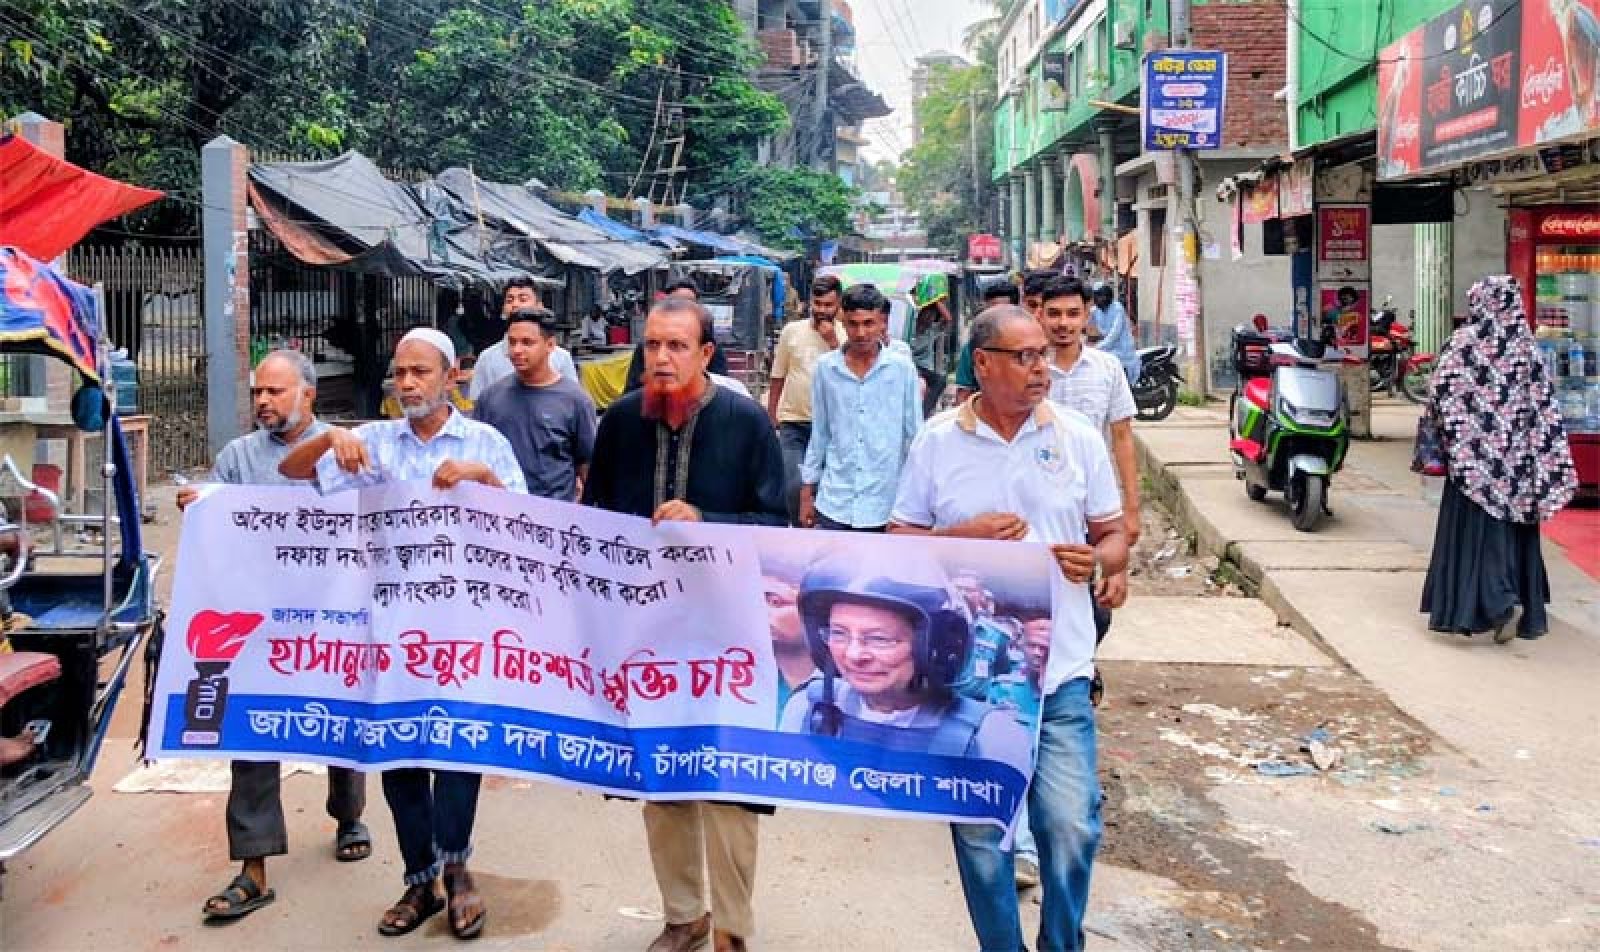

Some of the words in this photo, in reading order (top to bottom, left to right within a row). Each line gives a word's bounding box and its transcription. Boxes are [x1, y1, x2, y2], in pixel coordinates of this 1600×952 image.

[232, 506, 289, 531] অবৈধ
[296, 507, 355, 537] ইউনুস
[275, 545, 329, 567] দফায়
[398, 629, 484, 689] ইনুর
[687, 647, 758, 705] চাই
[246, 702, 349, 744] জাতীয়
[502, 722, 552, 760] দল
[650, 744, 837, 789] চাঁপাইনবাবগঞ্জ
[849, 766, 926, 798] জেলা
[931, 774, 1005, 806] শাখা
